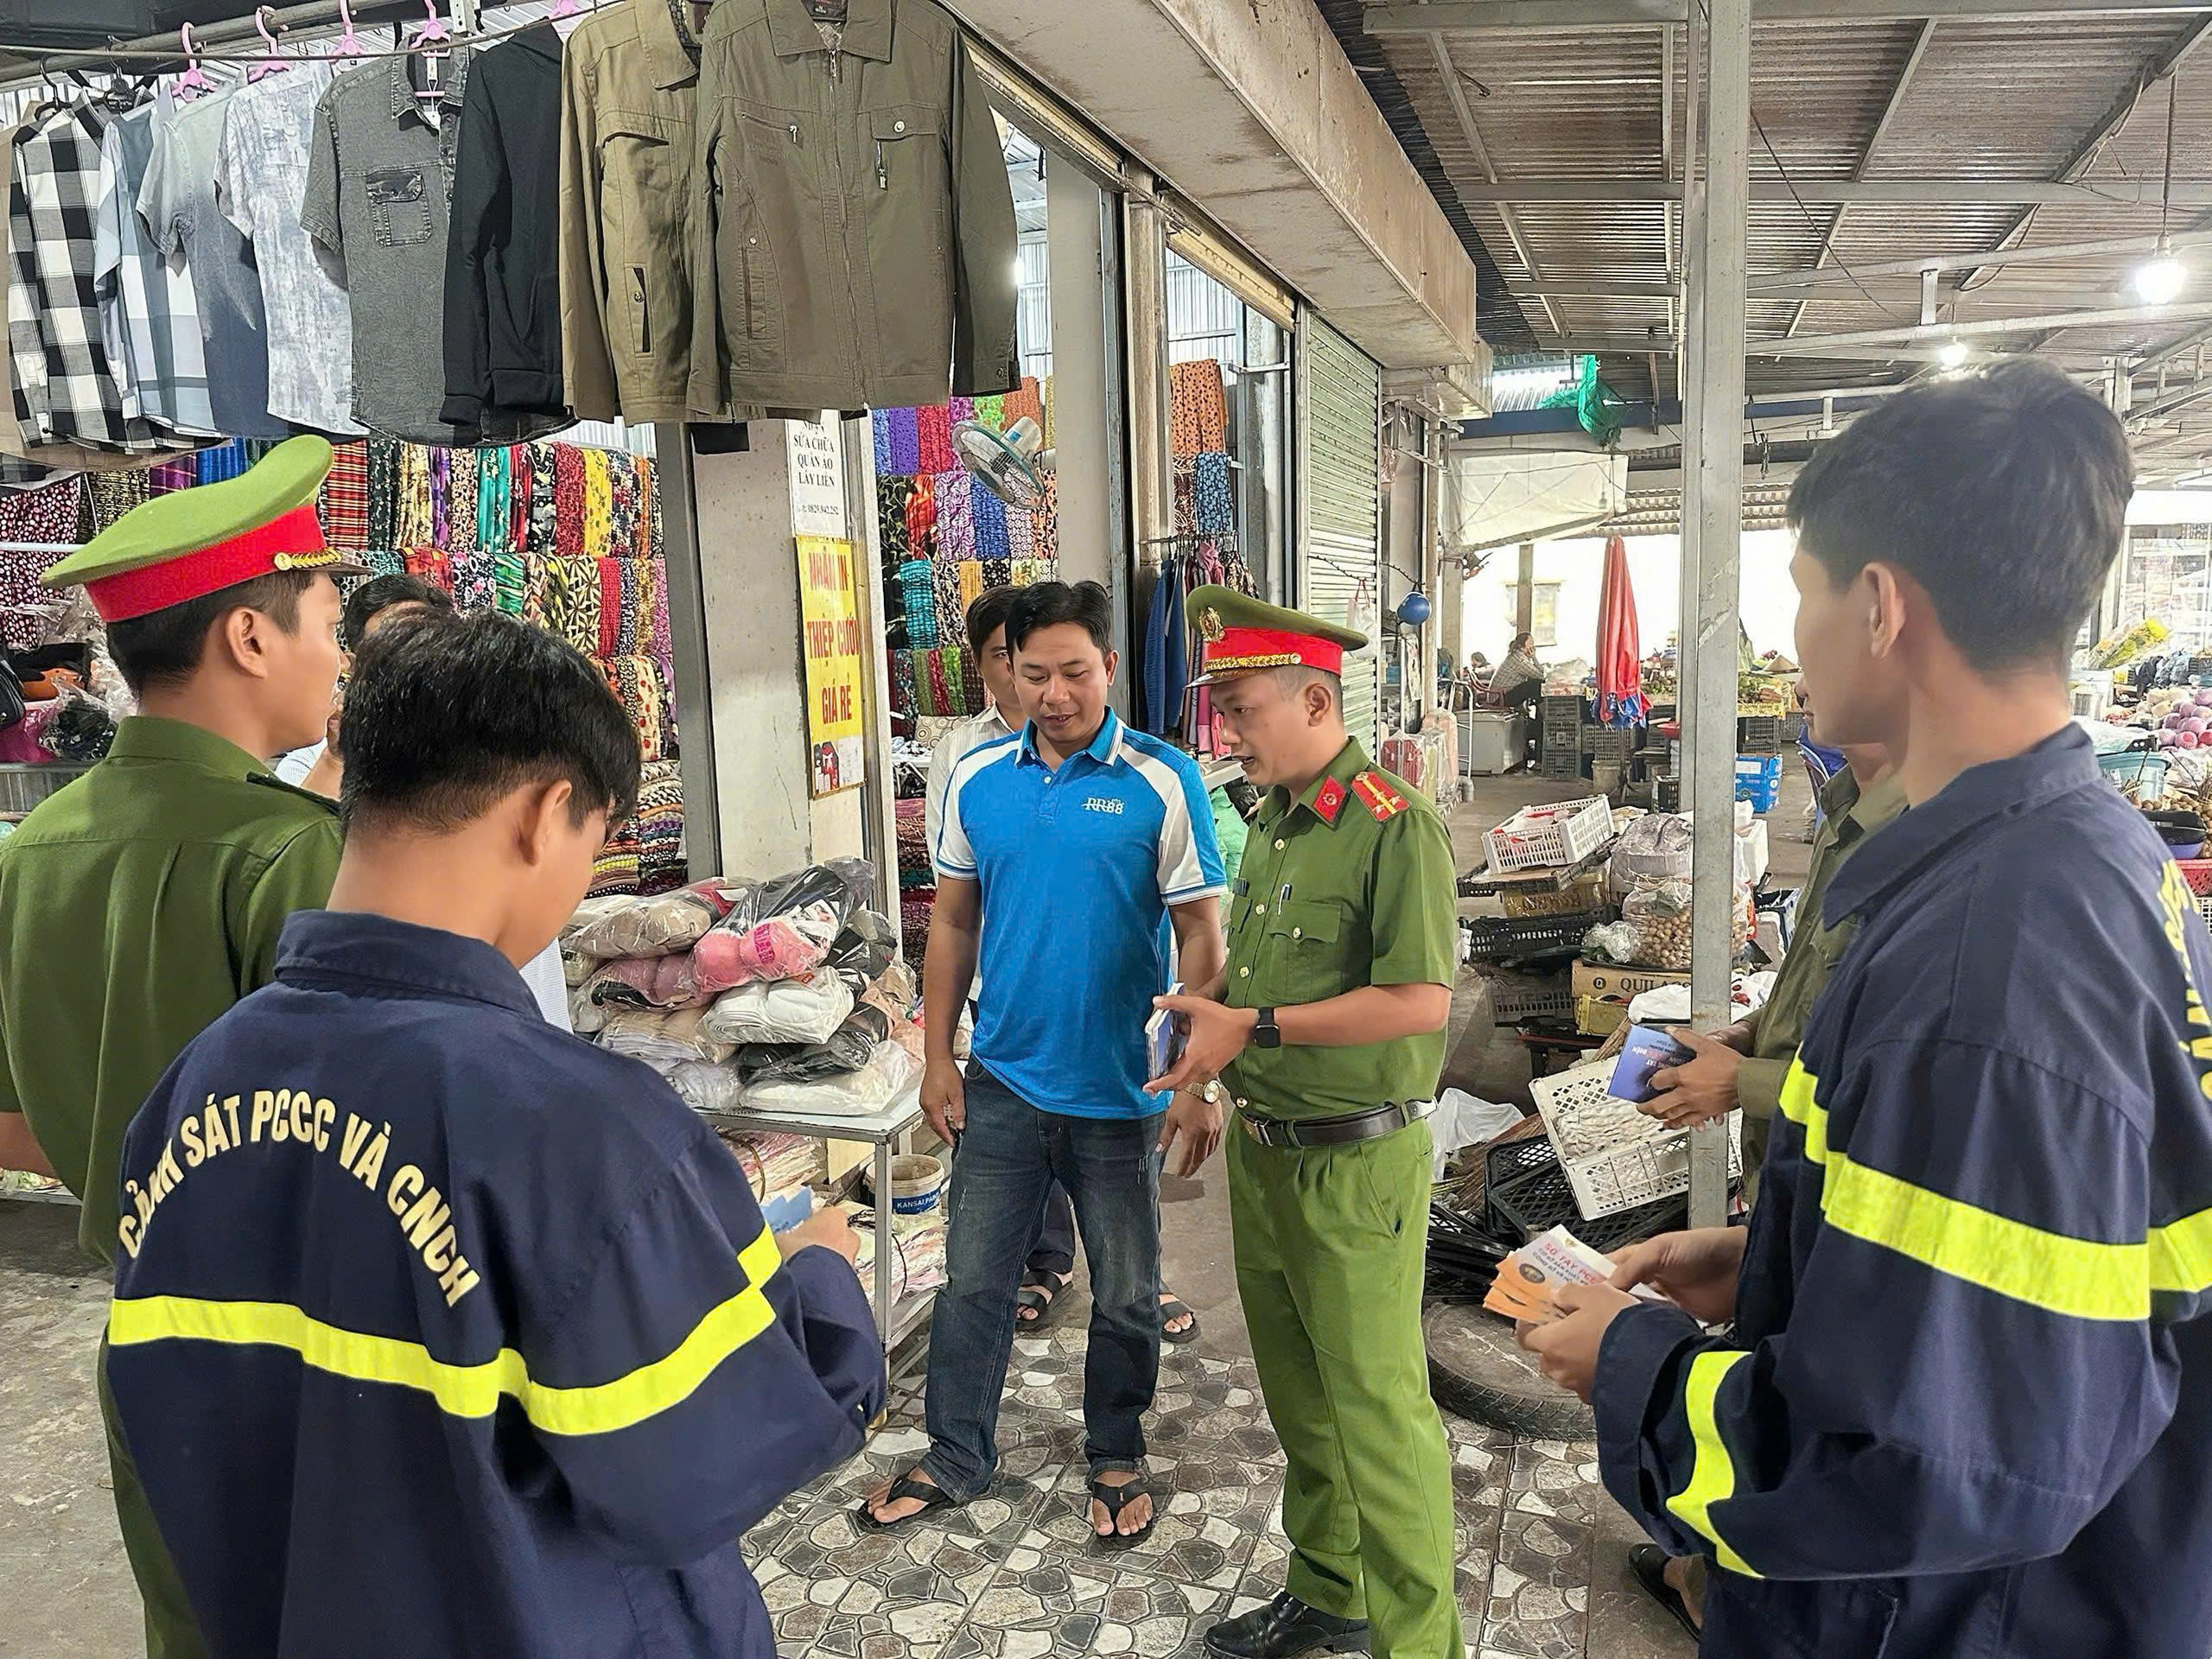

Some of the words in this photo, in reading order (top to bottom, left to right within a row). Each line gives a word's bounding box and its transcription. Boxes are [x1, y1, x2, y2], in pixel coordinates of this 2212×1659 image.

[837, 555, 849, 591] IN
[807, 613, 834, 666] THIỆP
[822, 678, 837, 724] GIÁ
[180, 1093, 241, 1168] SÁT
[250, 1088, 336, 1154] PCCC
[339, 1112, 392, 1192] VÀ
[386, 1164, 481, 1307] CNCH
[897, 1199, 924, 1209] KANSAI
